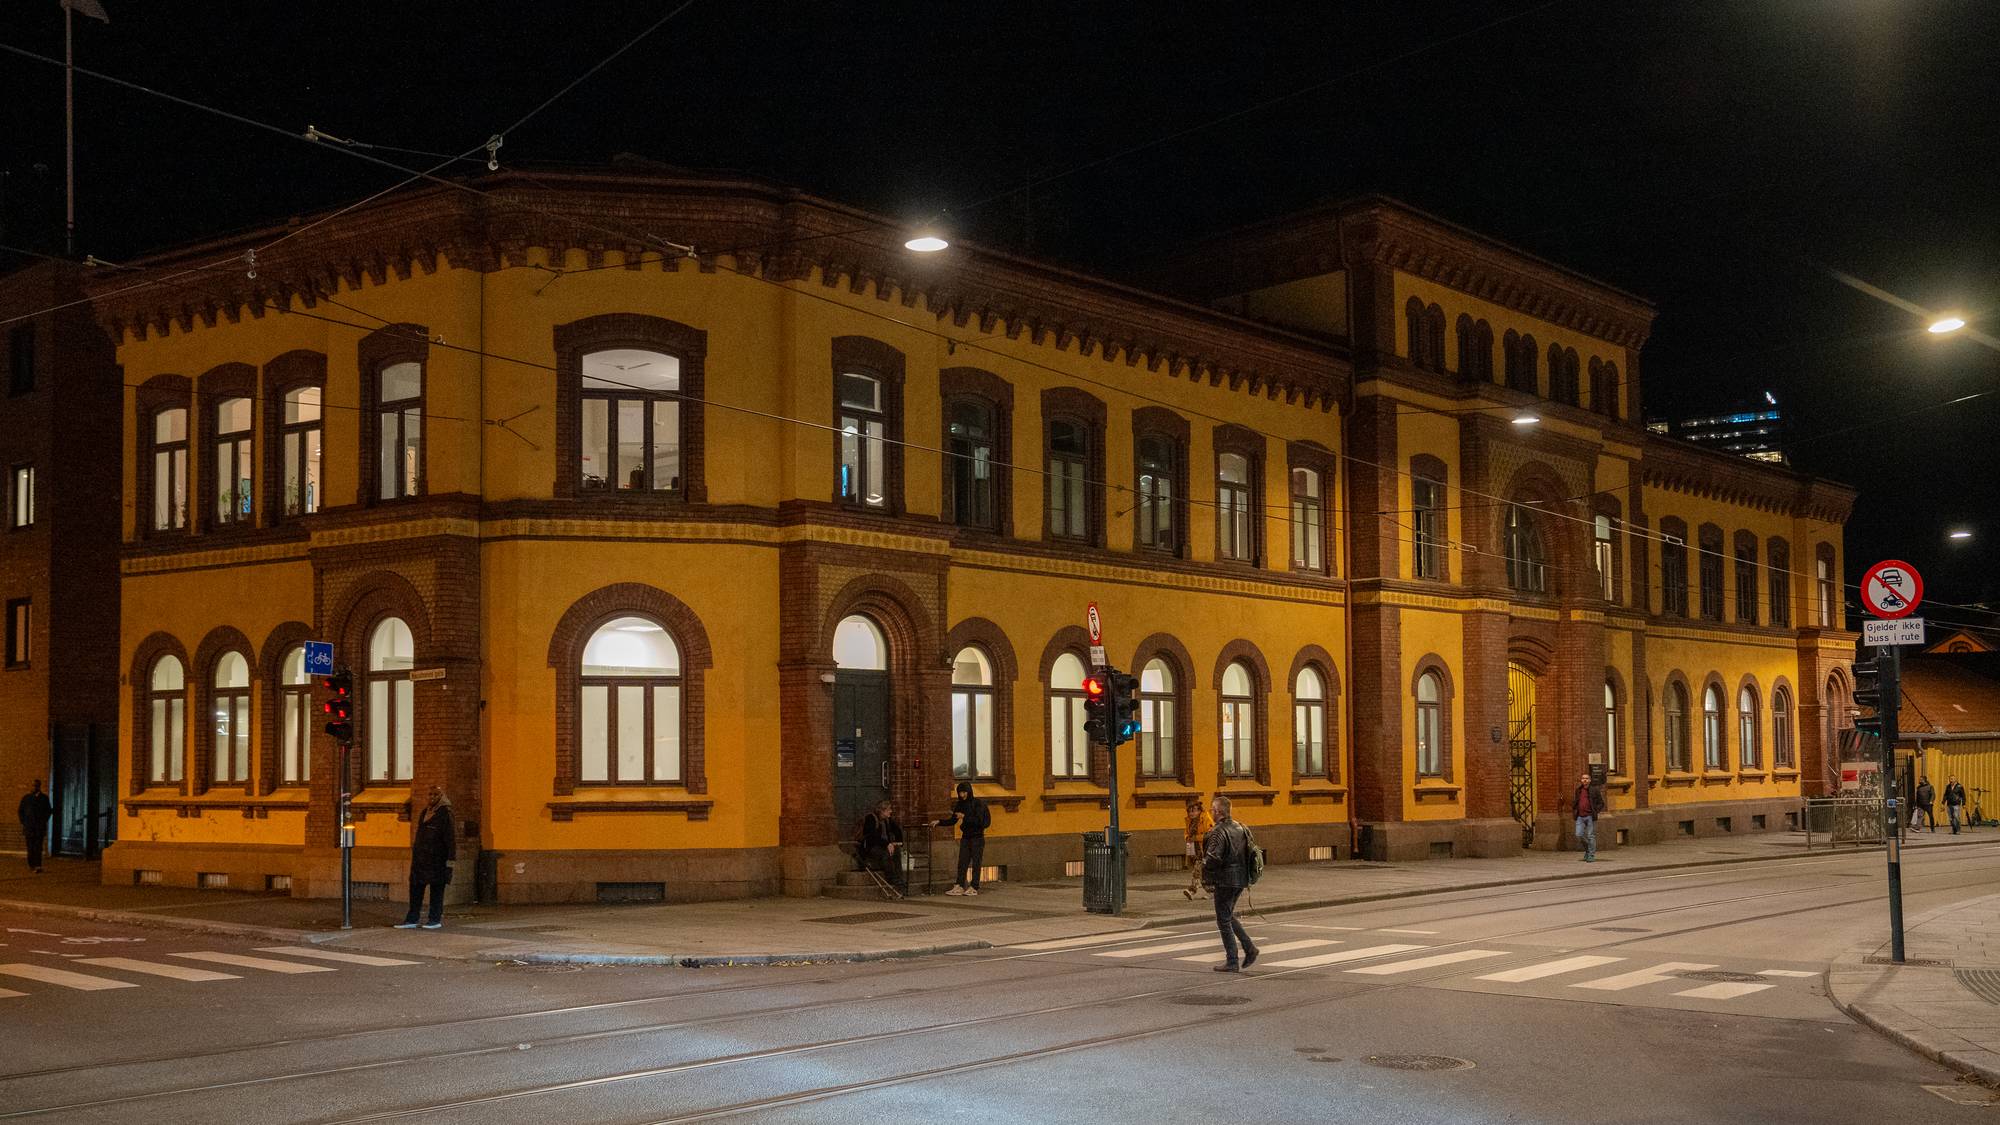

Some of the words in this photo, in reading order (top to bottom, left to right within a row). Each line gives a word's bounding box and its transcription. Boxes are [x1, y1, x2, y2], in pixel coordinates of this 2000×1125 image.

[1867, 623, 1897, 633] Gjelder
[1902, 621, 1921, 630] ikke
[1869, 634, 1889, 642] buss
[1901, 633, 1920, 641] rute
